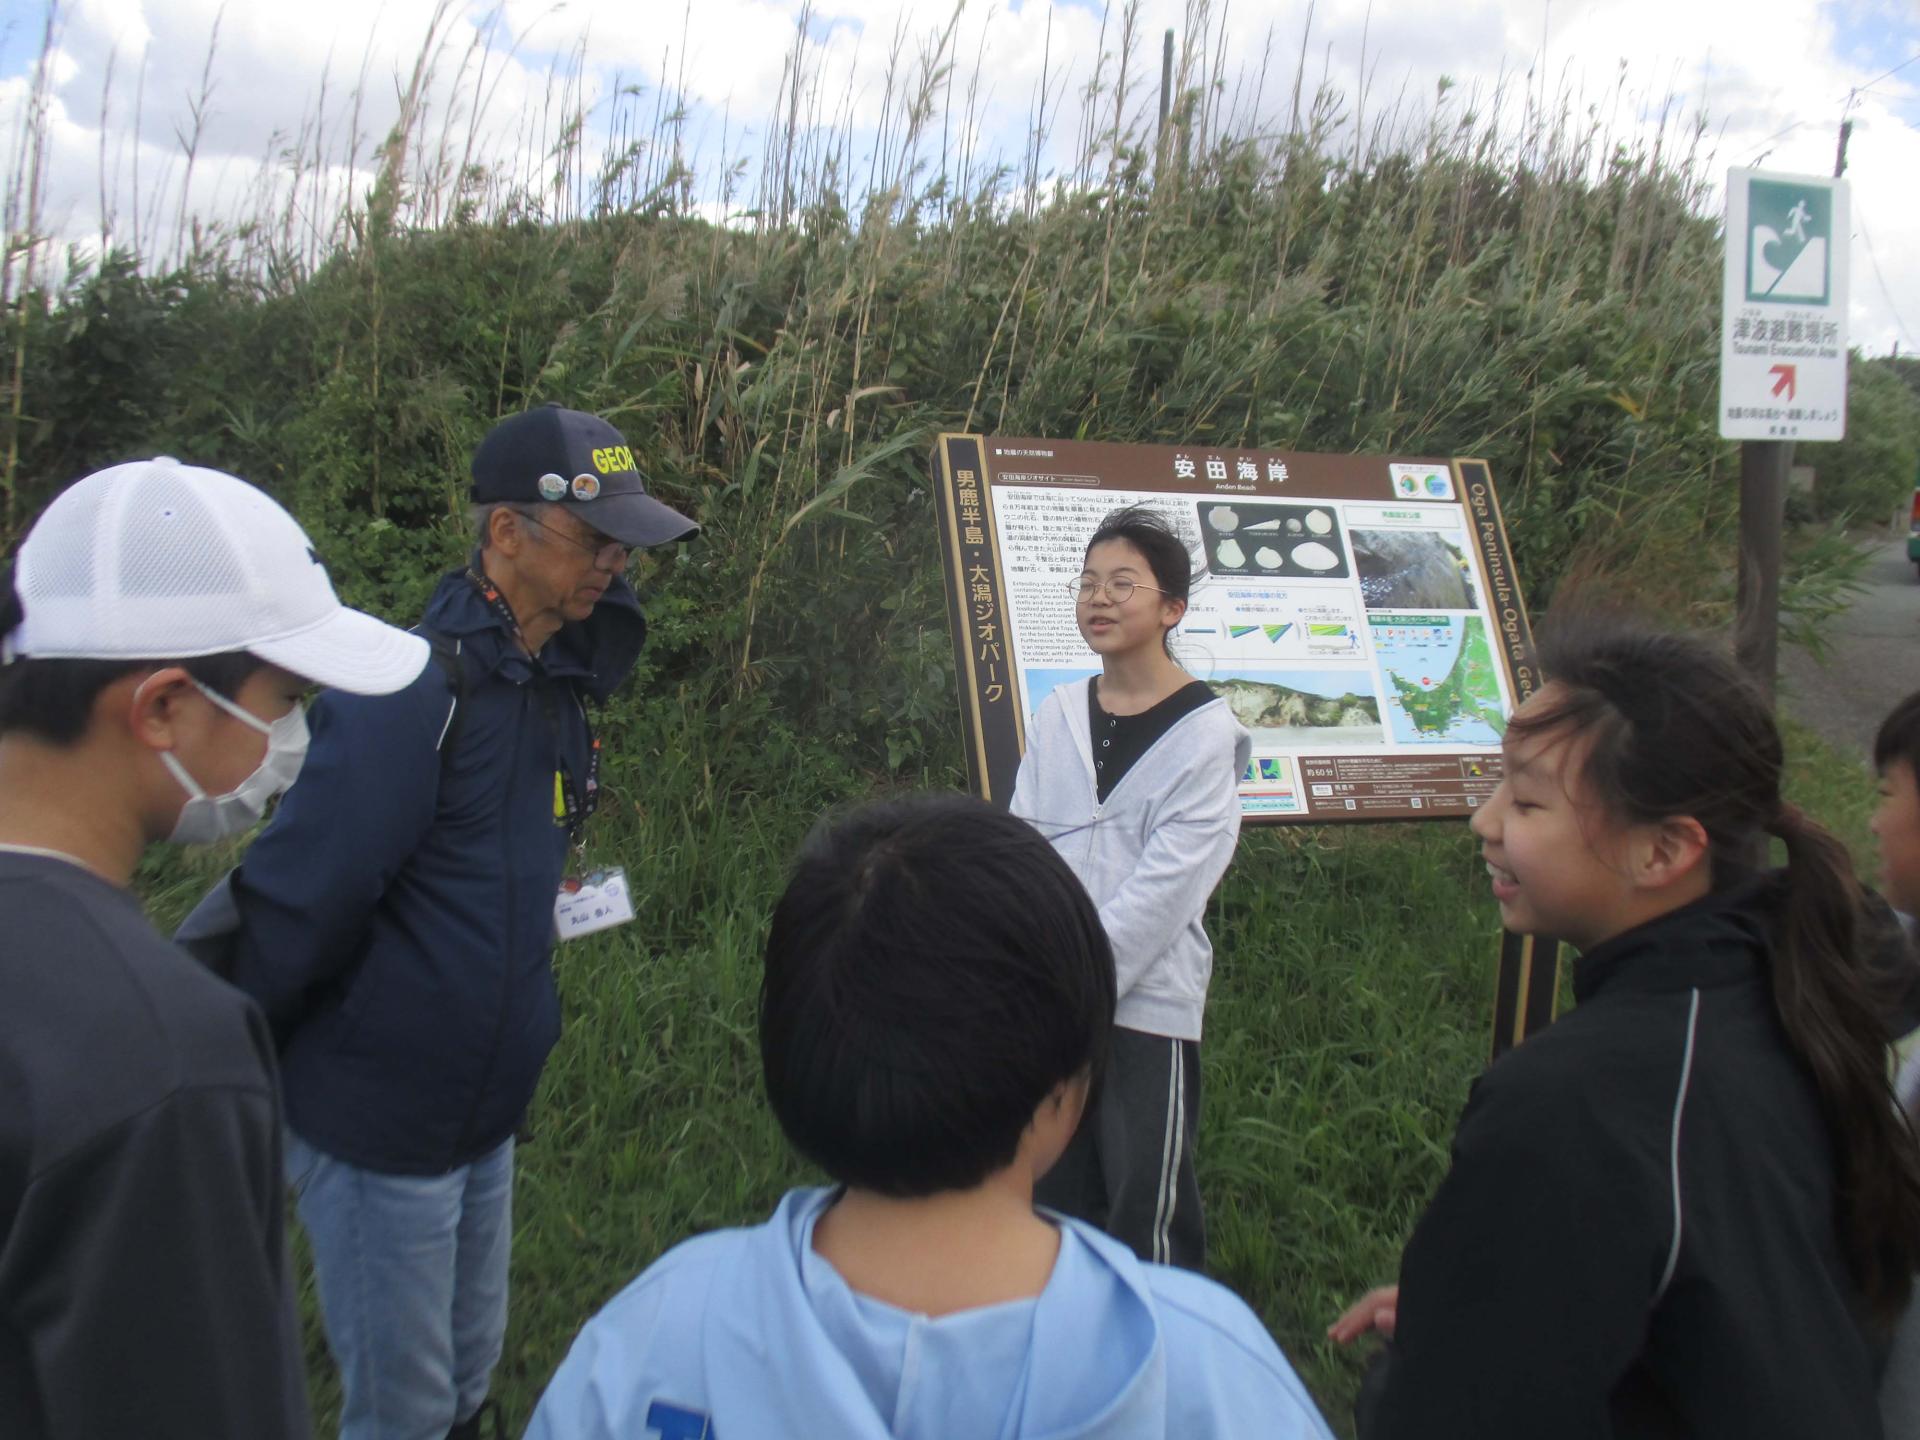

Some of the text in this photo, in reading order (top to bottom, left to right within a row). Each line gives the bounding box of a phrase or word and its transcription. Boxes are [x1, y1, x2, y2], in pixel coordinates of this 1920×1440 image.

[1732, 318, 1838, 344] 津波避難場所
[1733, 342, 1837, 358] Tsunami Evacuation Area
[1174, 459, 1289, 482] 安田海岸
[1471, 483, 1488, 517] Oga
[957, 469, 1003, 702] 男鹿半島・大潟ジオパーク
